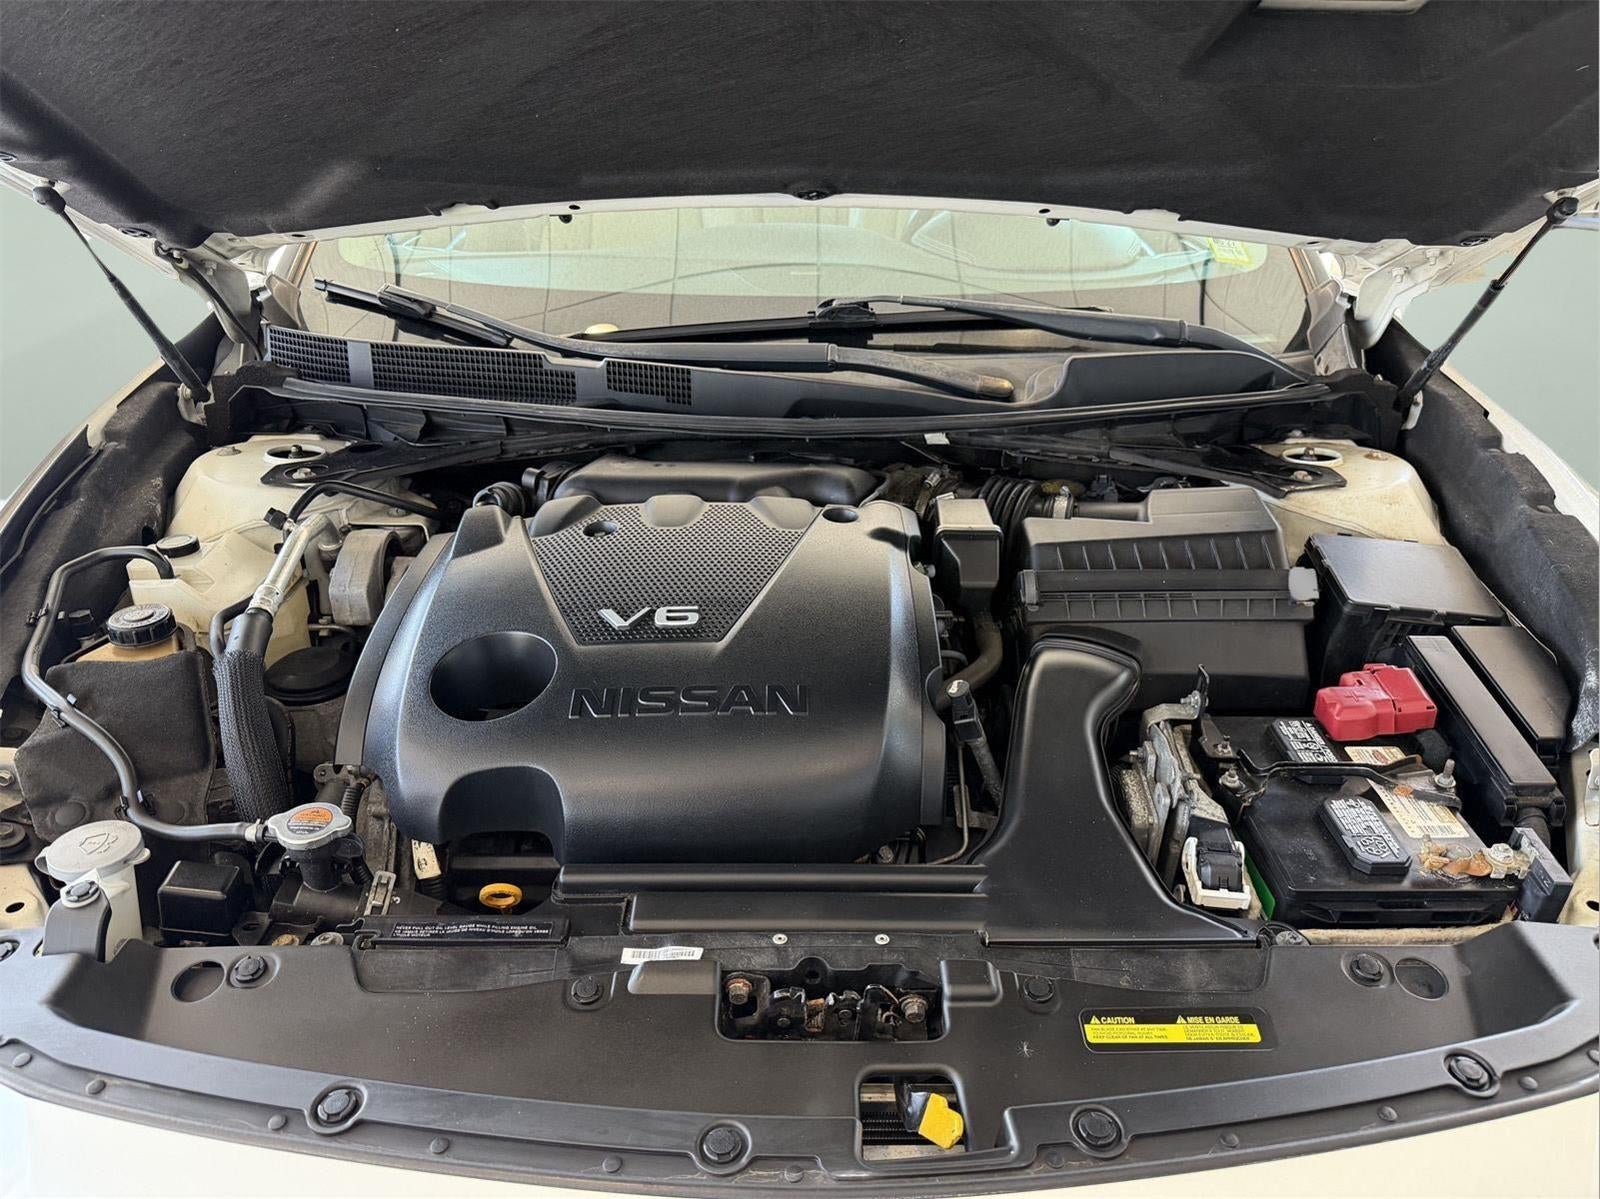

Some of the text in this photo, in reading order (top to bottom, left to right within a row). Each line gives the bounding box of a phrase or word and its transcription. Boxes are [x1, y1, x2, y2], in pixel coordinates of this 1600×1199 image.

[599, 605, 700, 630] V6
[568, 684, 809, 719] NISSAN
[1101, 1016, 1135, 1024] CAUTION
[1186, 1016, 1240, 1024] MISE EN GARDE
